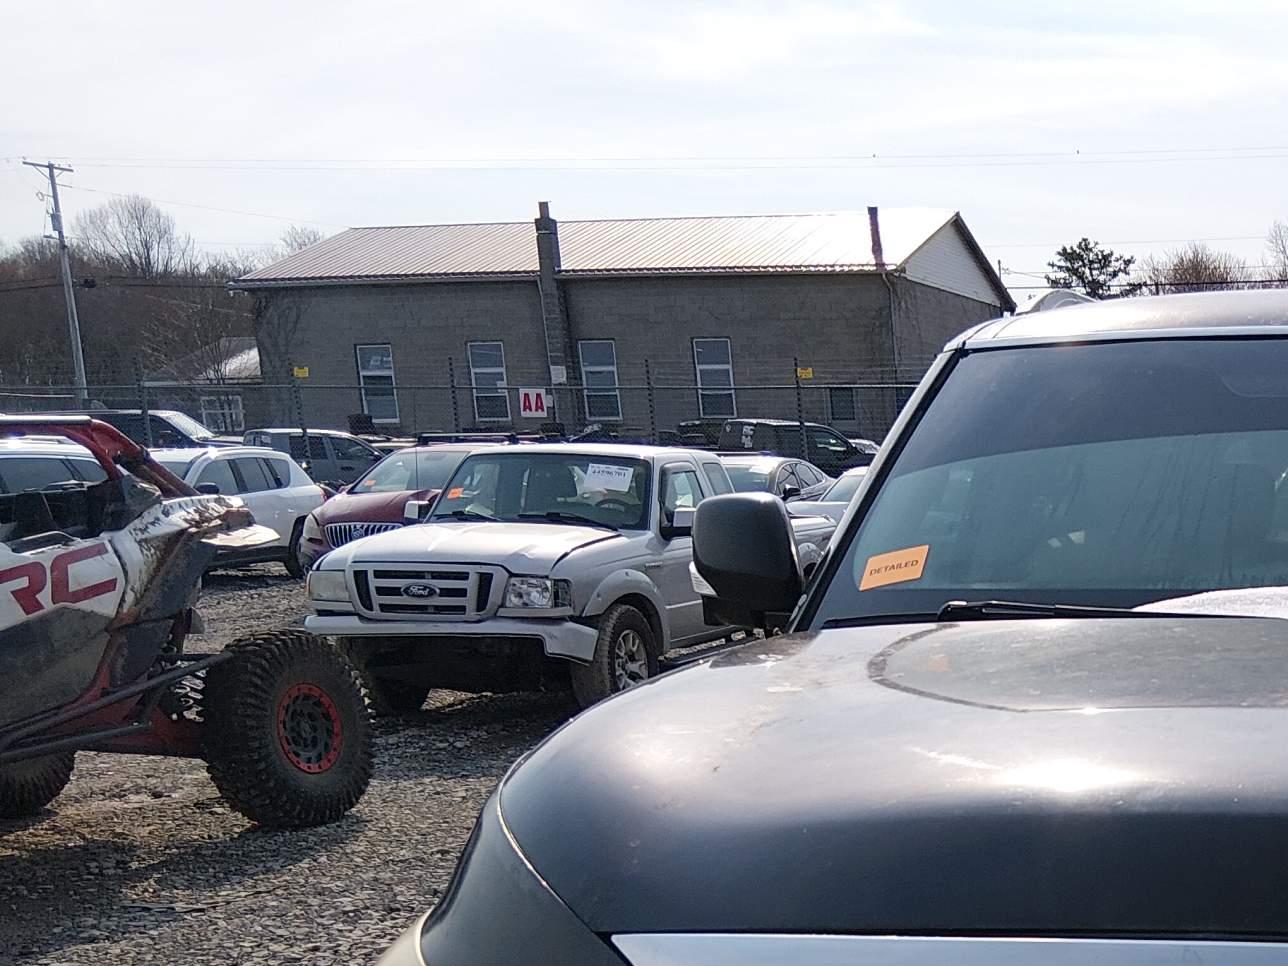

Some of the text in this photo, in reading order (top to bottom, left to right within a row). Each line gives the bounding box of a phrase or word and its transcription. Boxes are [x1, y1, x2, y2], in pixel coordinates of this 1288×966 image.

[522, 392, 545, 412] AA
[869, 560, 919, 576] DETAILED
[409, 585, 430, 597] Ford
